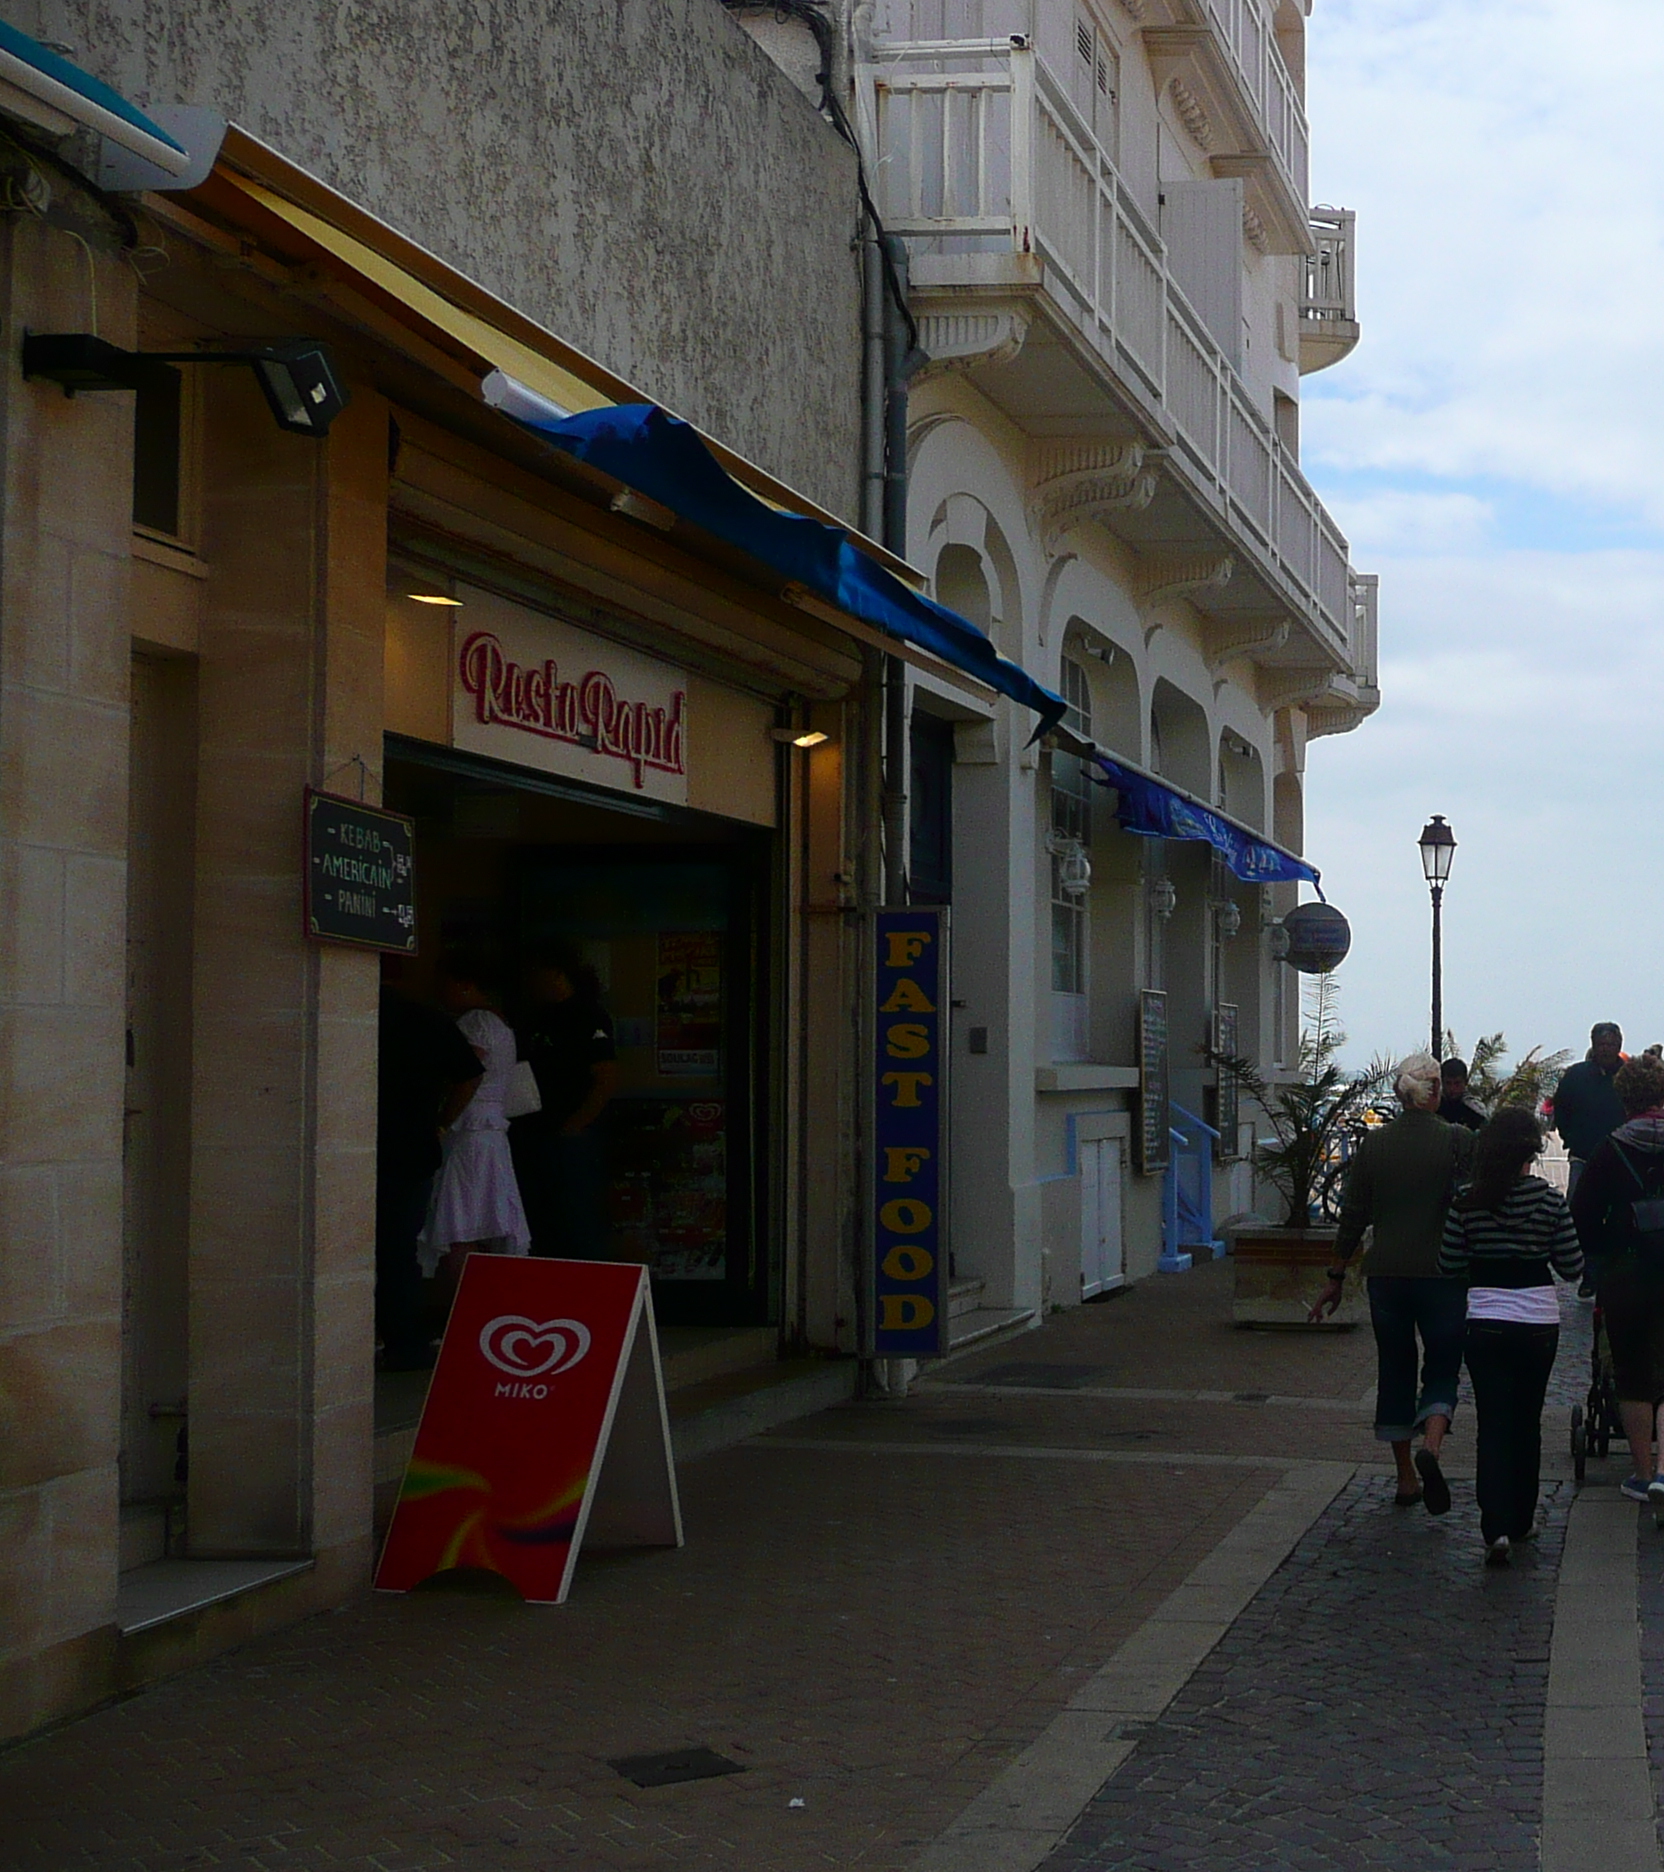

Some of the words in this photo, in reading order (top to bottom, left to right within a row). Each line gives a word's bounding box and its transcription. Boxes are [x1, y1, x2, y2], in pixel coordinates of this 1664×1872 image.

[460, 631, 578, 738] Resto
[580, 671, 685, 789] Rapid
[339, 823, 381, 853] KEBAB
[879, 931, 936, 1107] FAST
[879, 1147, 935, 1330] FOOD
[494, 1382, 548, 1399] MIKO
